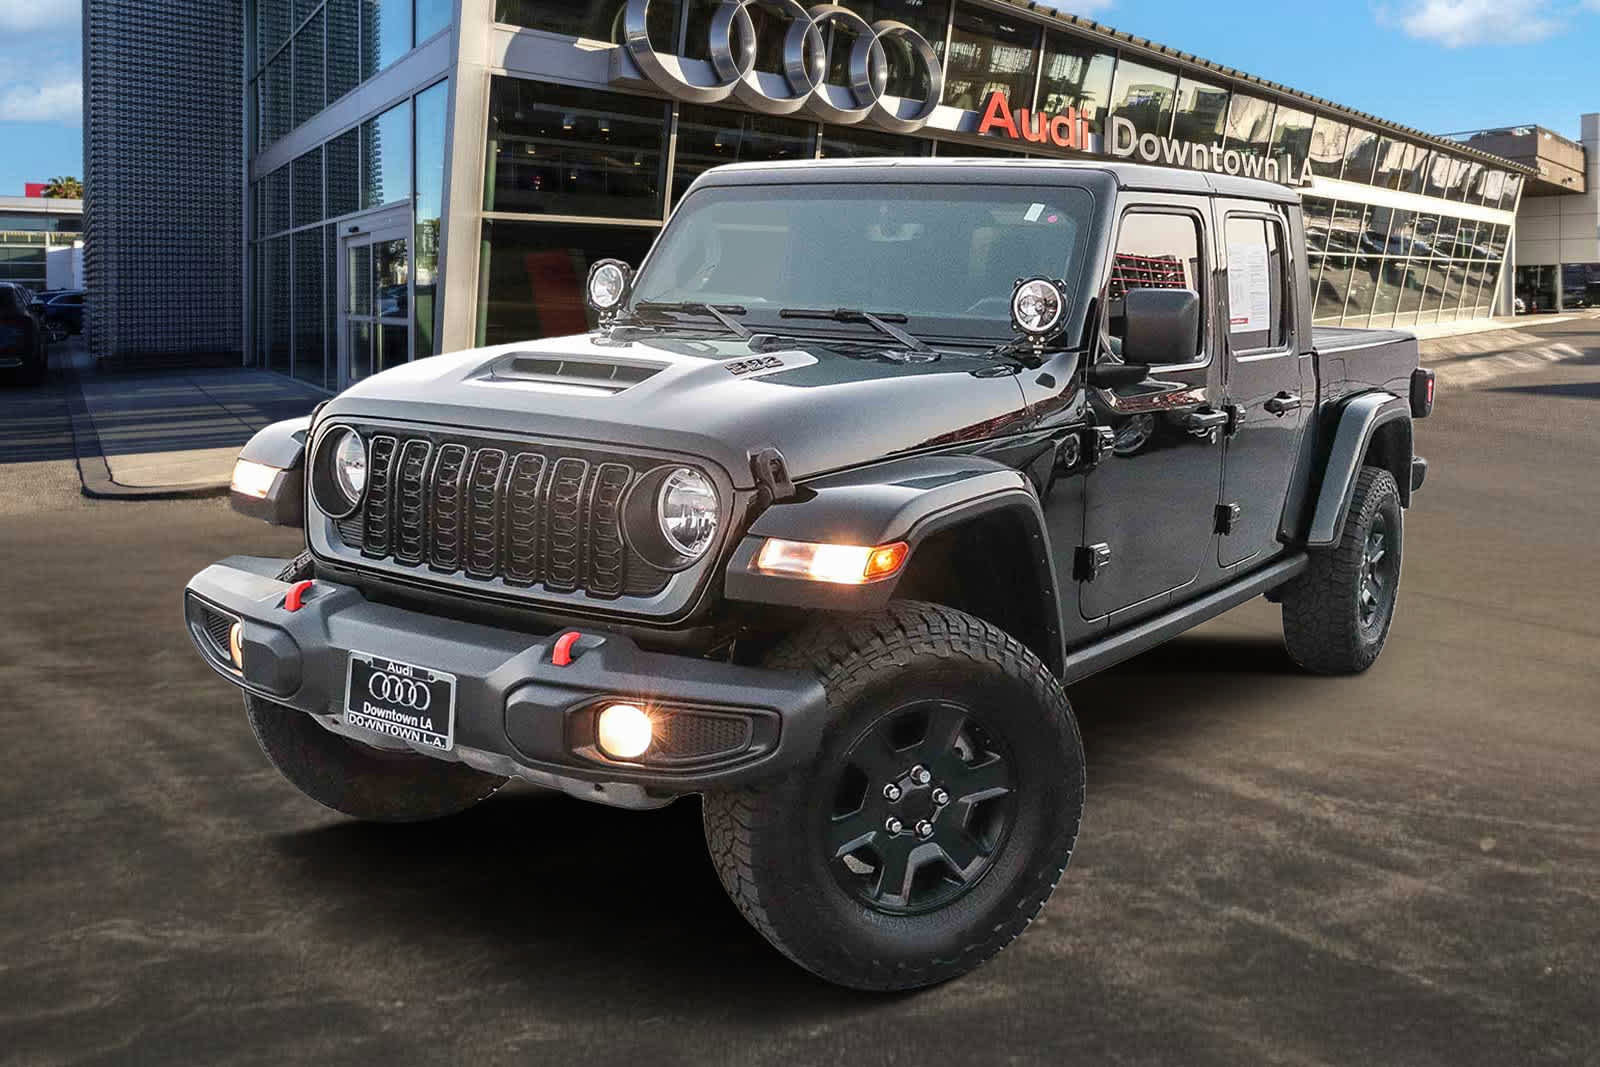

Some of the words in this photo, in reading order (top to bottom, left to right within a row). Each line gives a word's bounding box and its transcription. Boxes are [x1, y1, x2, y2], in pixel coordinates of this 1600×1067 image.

[978, 91, 1089, 151] Audi
[1107, 116, 1279, 183] Downtown
[1283, 155, 1314, 187] LA
[387, 662, 413, 677] Audi
[349, 713, 420, 741] DOWNTOWN
[423, 734, 446, 748] L.A.
[363, 701, 418, 727] Downtown
[420, 716, 433, 731] LA
